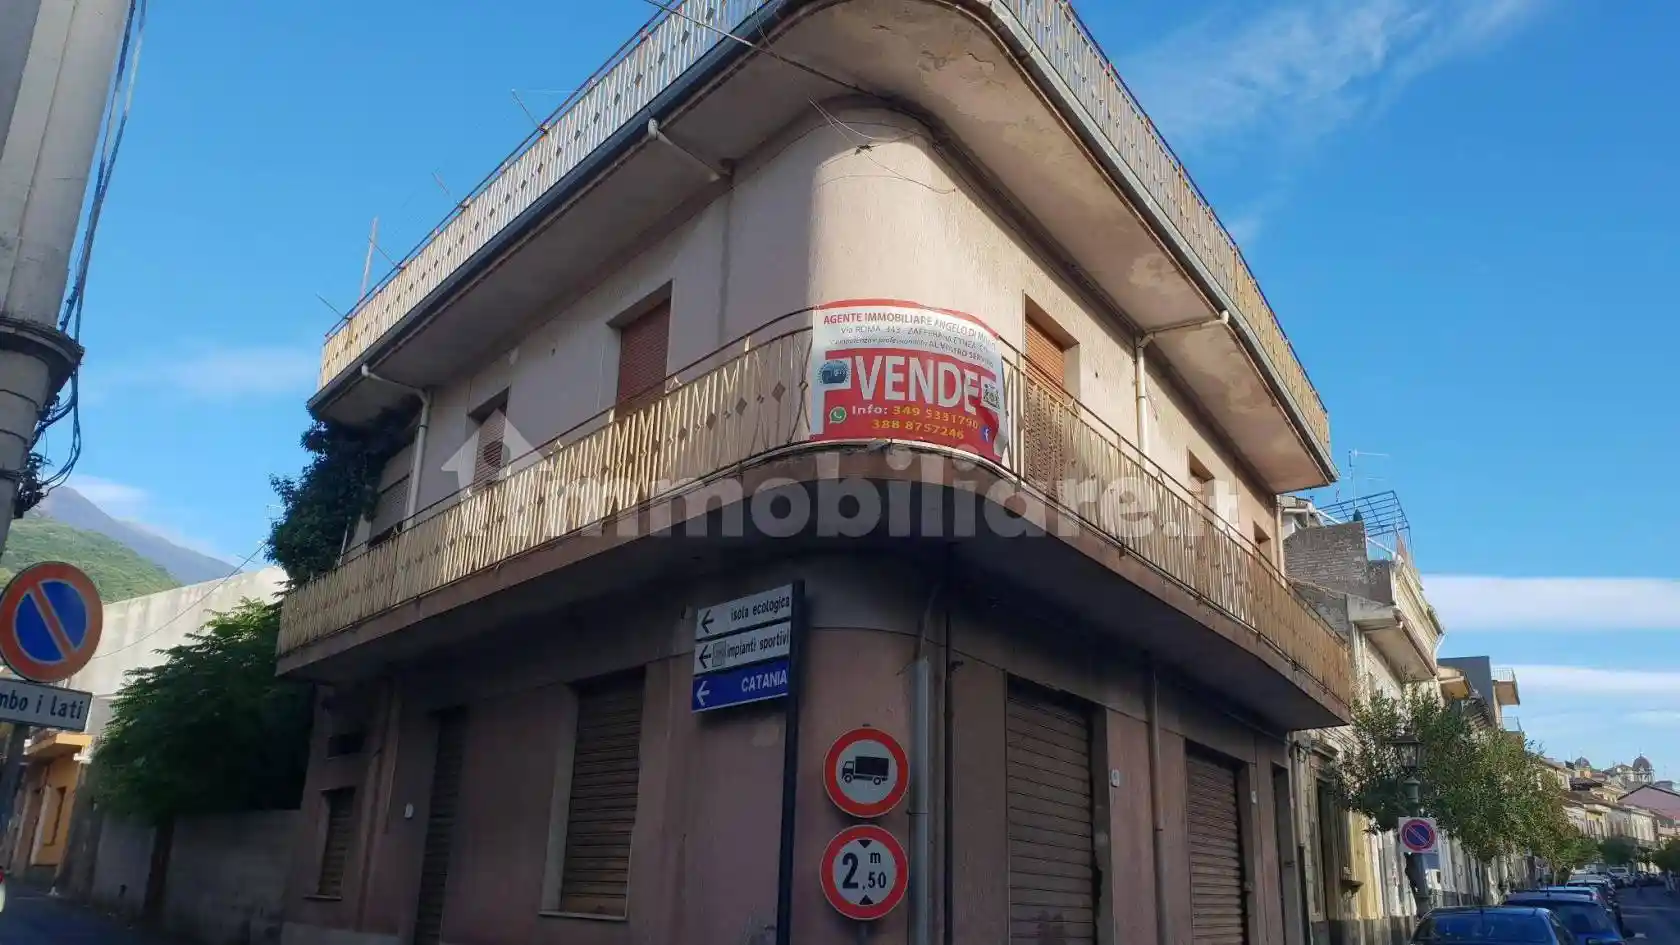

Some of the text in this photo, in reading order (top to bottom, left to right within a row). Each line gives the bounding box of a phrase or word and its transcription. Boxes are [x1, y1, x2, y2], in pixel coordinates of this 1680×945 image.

[824, 312, 863, 325] AGENTE
[865, 312, 933, 326] IMMOBILIARE
[934, 318, 967, 334] ANGELO
[855, 355, 980, 415] VENDE
[852, 404, 888, 416] Info:
[892, 405, 920, 416] 349
[871, 419, 900, 430] 388
[731, 596, 790, 621] isola ecologica
[727, 627, 790, 658] impianti sportivi
[741, 669, 788, 692] CATANIA
[36, 694, 44, 714] i
[50, 695, 84, 719] Lati
[869, 852, 881, 864] m
